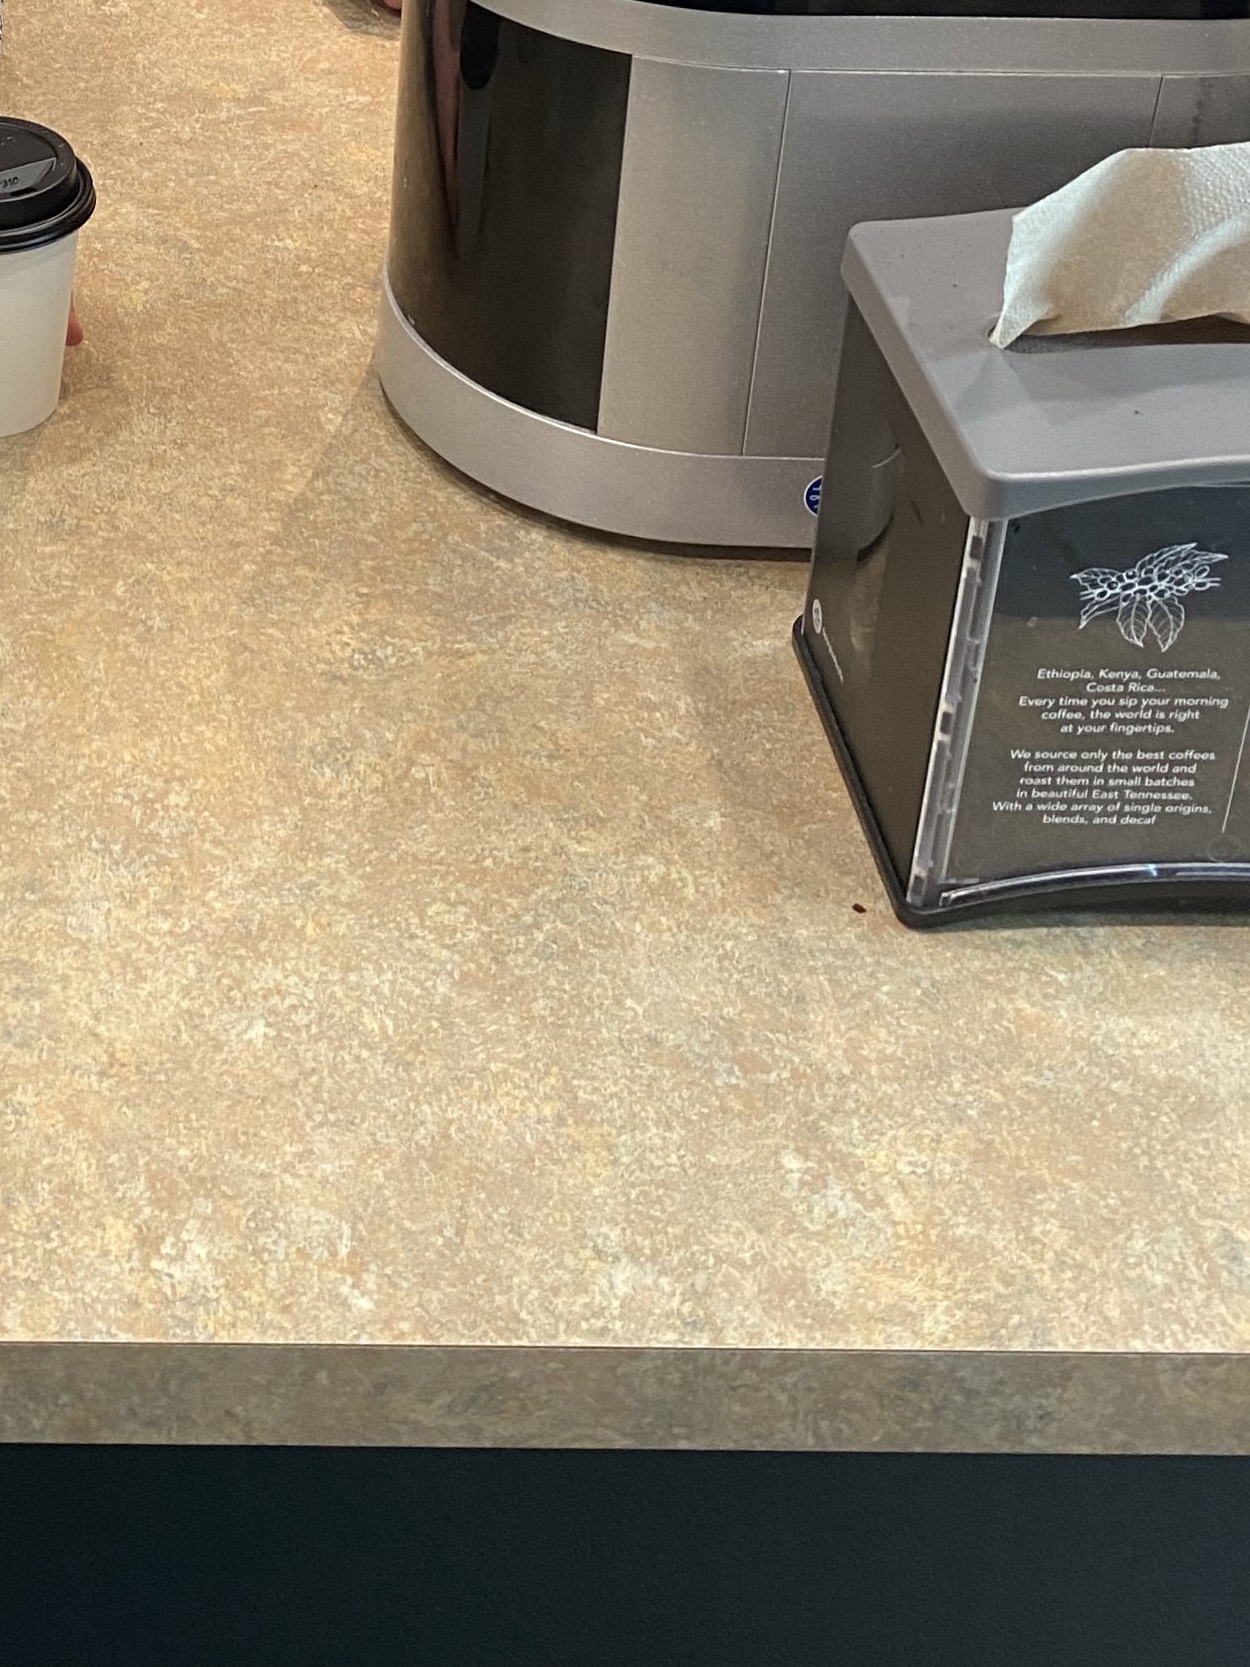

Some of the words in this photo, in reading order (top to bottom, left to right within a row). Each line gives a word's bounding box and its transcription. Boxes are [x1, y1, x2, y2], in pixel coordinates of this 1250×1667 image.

[1037, 668, 1094, 681] Ethiopia,
[1099, 668, 1142, 682] Kenya,
[1146, 668, 1221, 680] Guatemala,
[1086, 682, 1124, 693] Costa
[1019, 696, 1055, 708] Every
[1059, 696, 1088, 706] time
[1091, 698, 1116, 709] you
[1118, 696, 1138, 709] sip
[1140, 698, 1170, 710] your
[1174, 697, 1229, 709] morning
[1041, 709, 1086, 721] coffee,
[1090, 709, 1111, 719] the
[1115, 709, 1151, 719] world
[1155, 710, 1166, 720] is
[1169, 709, 1200, 722] right
[1060, 723, 1073, 733] at
[1077, 724, 1105, 735] your
[1110, 722, 1175, 735] fingertips.
[1010, 750, 1031, 760] We
[1035, 751, 1077, 760] source
[1081, 750, 1108, 762] only
[1112, 750, 1133, 760] the
[1136, 750, 1165, 760] best
[1169, 750, 1216, 761] coffees
[1023, 761, 1054, 772] from
[1058, 762, 1104, 773] around
[1107, 762, 1128, 773] the
[1132, 762, 1169, 774] world
[1172, 763, 1197, 774] and
[1020, 775, 1052, 785] roast
[1056, 775, 1090, 785] them
[1093, 775, 1105, 785] in
[1109, 775, 1142, 786] small
[1145, 775, 1195, 787] batches
[1016, 788, 1028, 798] in
[1031, 788, 1088, 799] beautiful
[1092, 789, 1119, 799] East
[1123, 790, 1193, 800] Tennessee.
[992, 801, 1022, 811] With
[1025, 803, 1033, 811] a
[1036, 801, 1068, 811] wide
[1070, 803, 1104, 814] array
[1107, 801, 1121, 812] of
[1123, 802, 1162, 814] single
[1164, 803, 1212, 816] origins,
[1043, 814, 1088, 825] blends,
[1092, 815, 1117, 825] and
[1120, 814, 1157, 825] decaf
